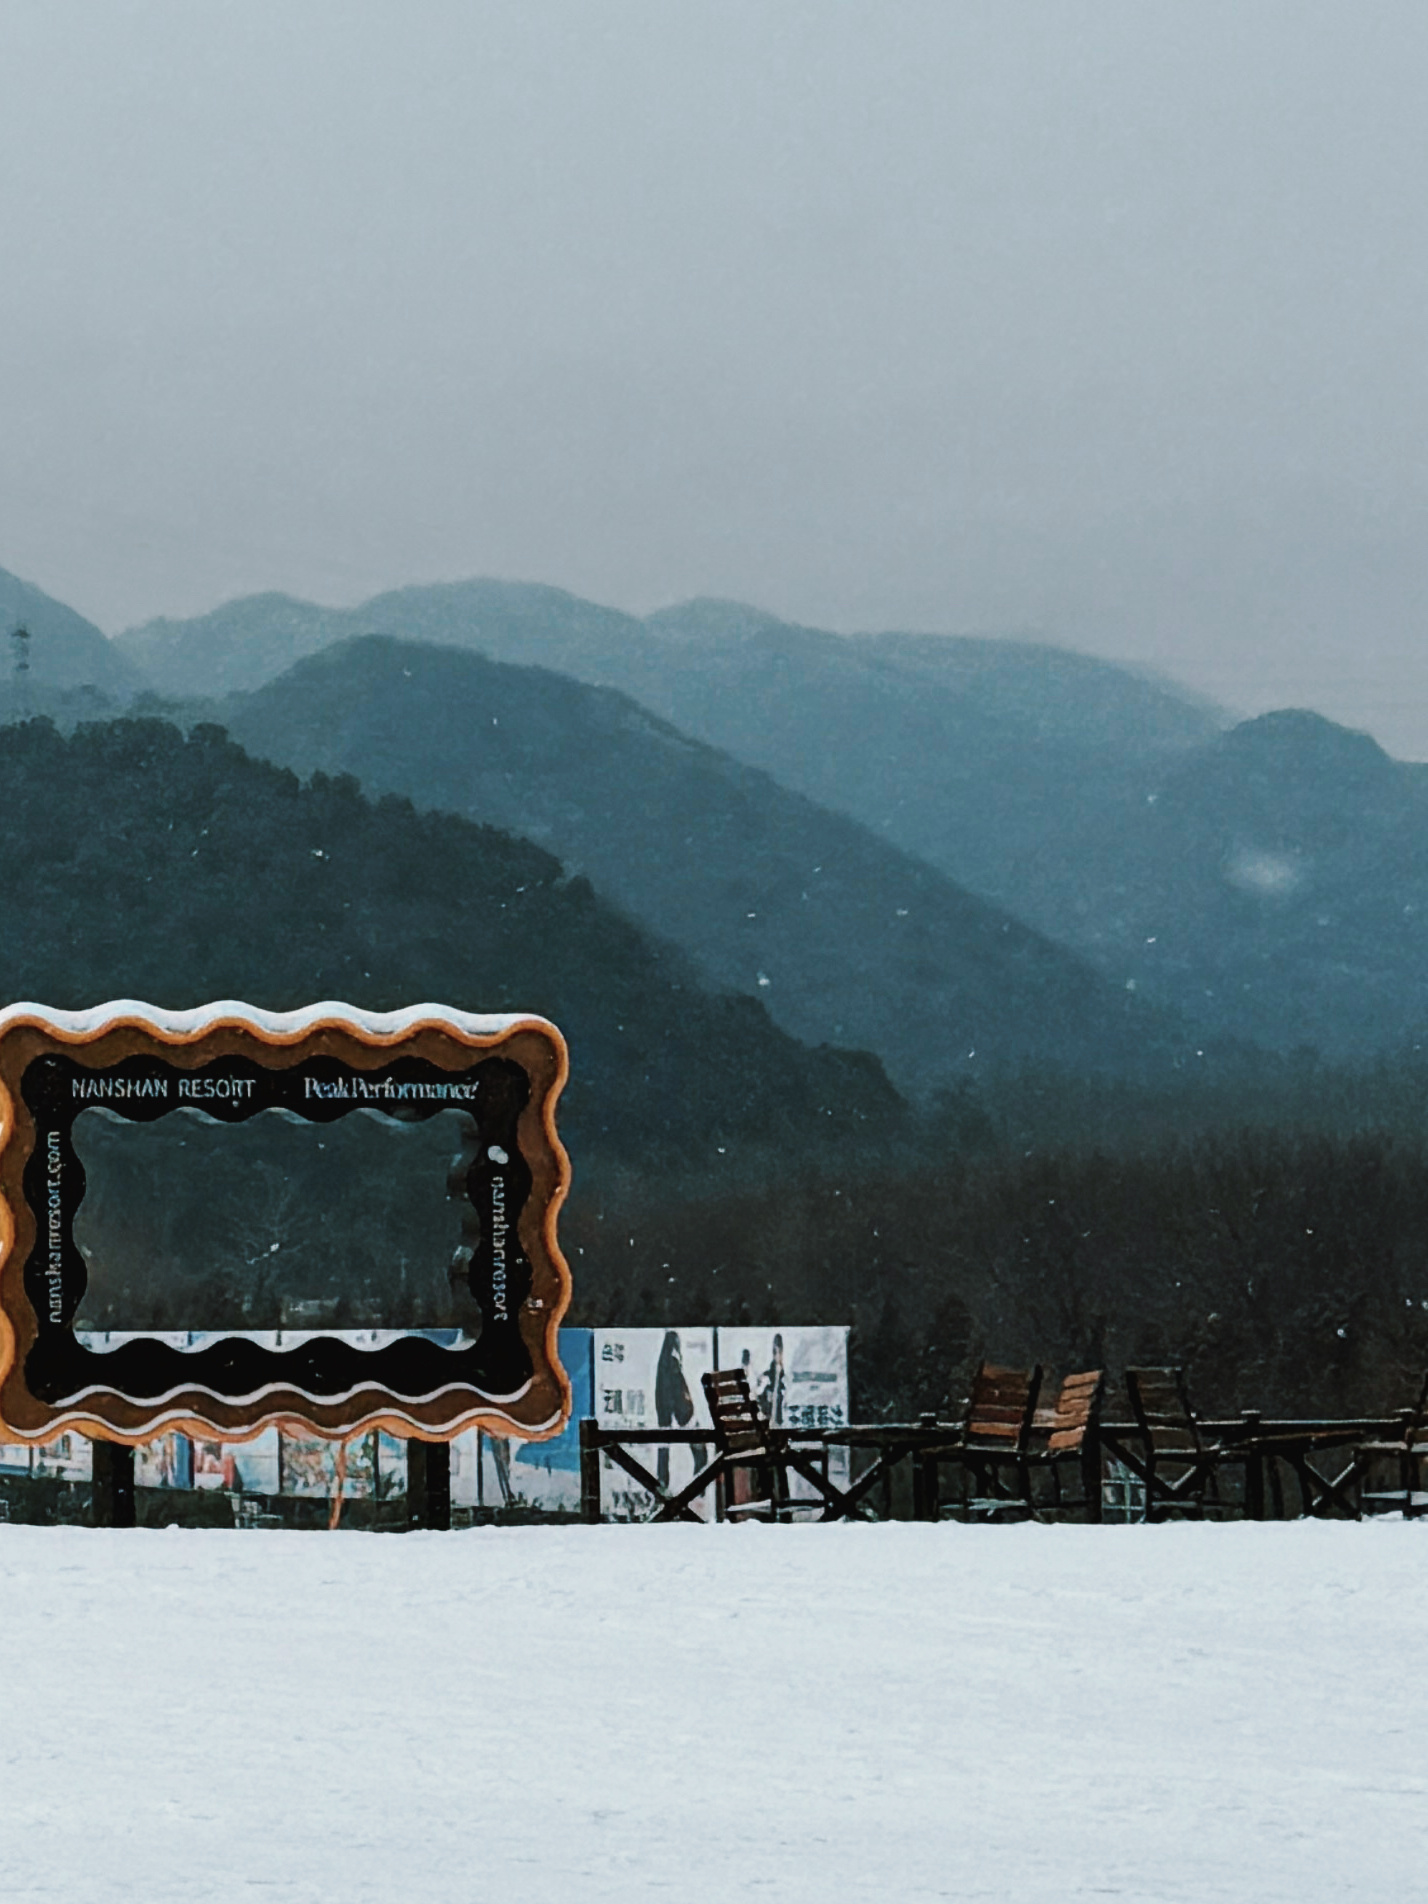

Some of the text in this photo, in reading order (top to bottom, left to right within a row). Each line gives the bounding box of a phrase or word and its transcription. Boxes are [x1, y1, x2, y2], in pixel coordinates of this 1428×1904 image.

[72, 1078, 257, 1098] NANSHAN RESORT
[44, 1130, 63, 1323] nanshanresort.com
[491, 1176, 510, 1321] nanshanresort
